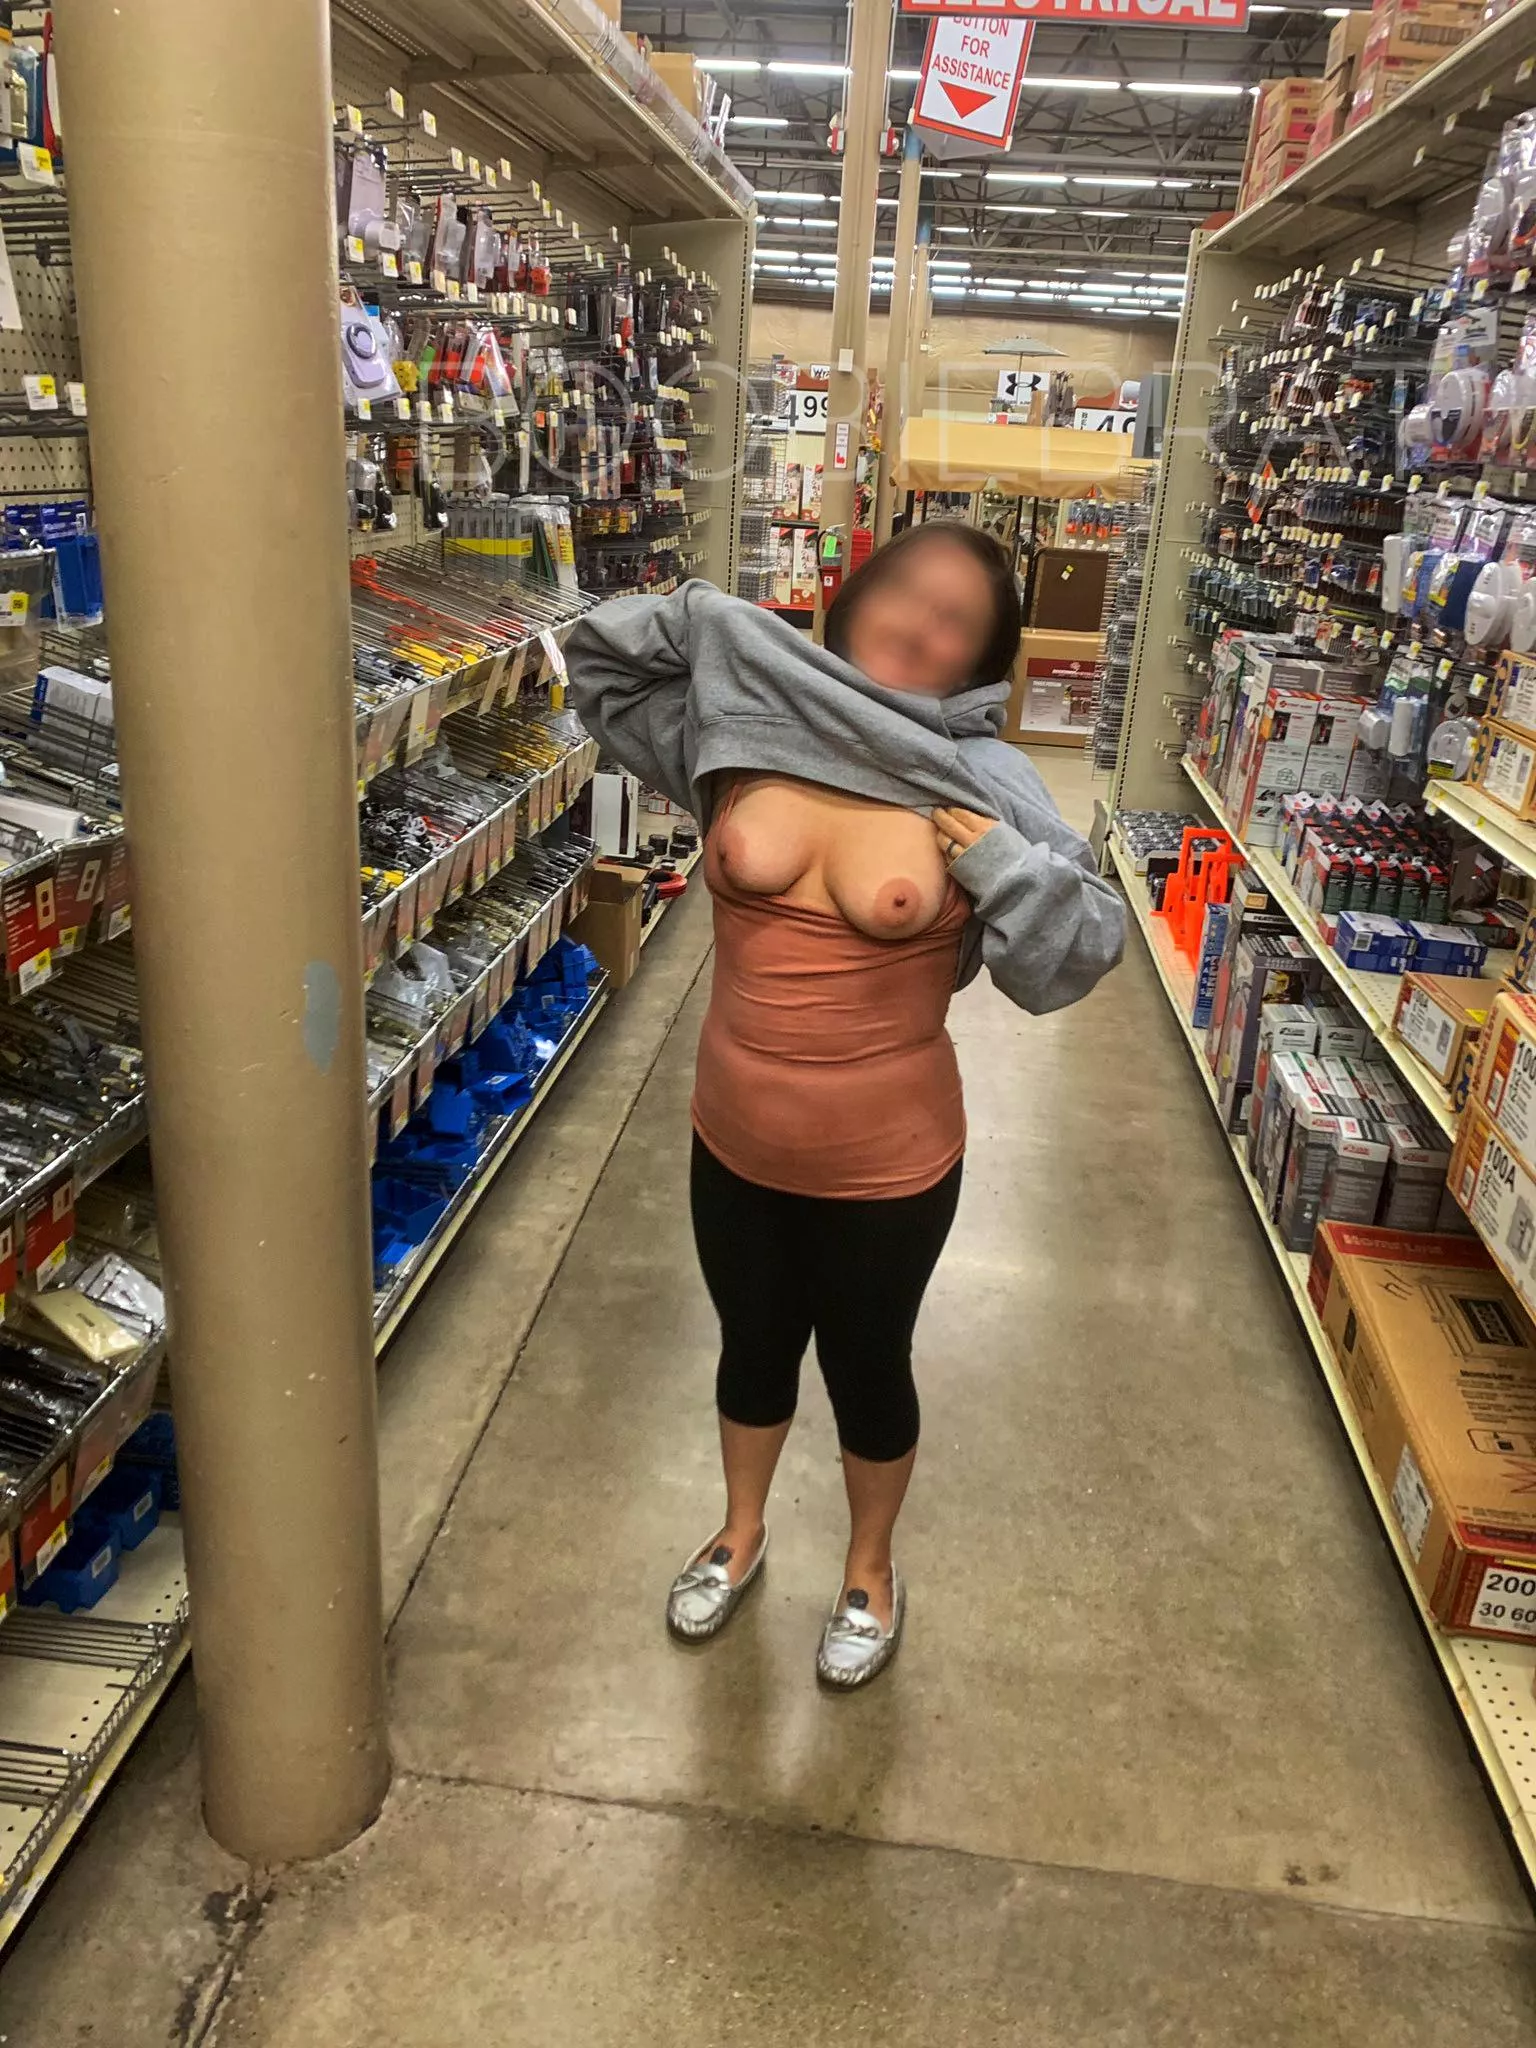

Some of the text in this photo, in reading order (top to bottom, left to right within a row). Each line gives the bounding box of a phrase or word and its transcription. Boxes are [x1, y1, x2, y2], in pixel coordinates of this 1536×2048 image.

[961, 35, 990, 58] FOR
[932, 53, 1011, 90] ASSISTANCE
[1489, 1140, 1515, 1193] 100A
[1479, 1602, 1506, 1619] 30
[1511, 1607, 1536, 1623] 60
